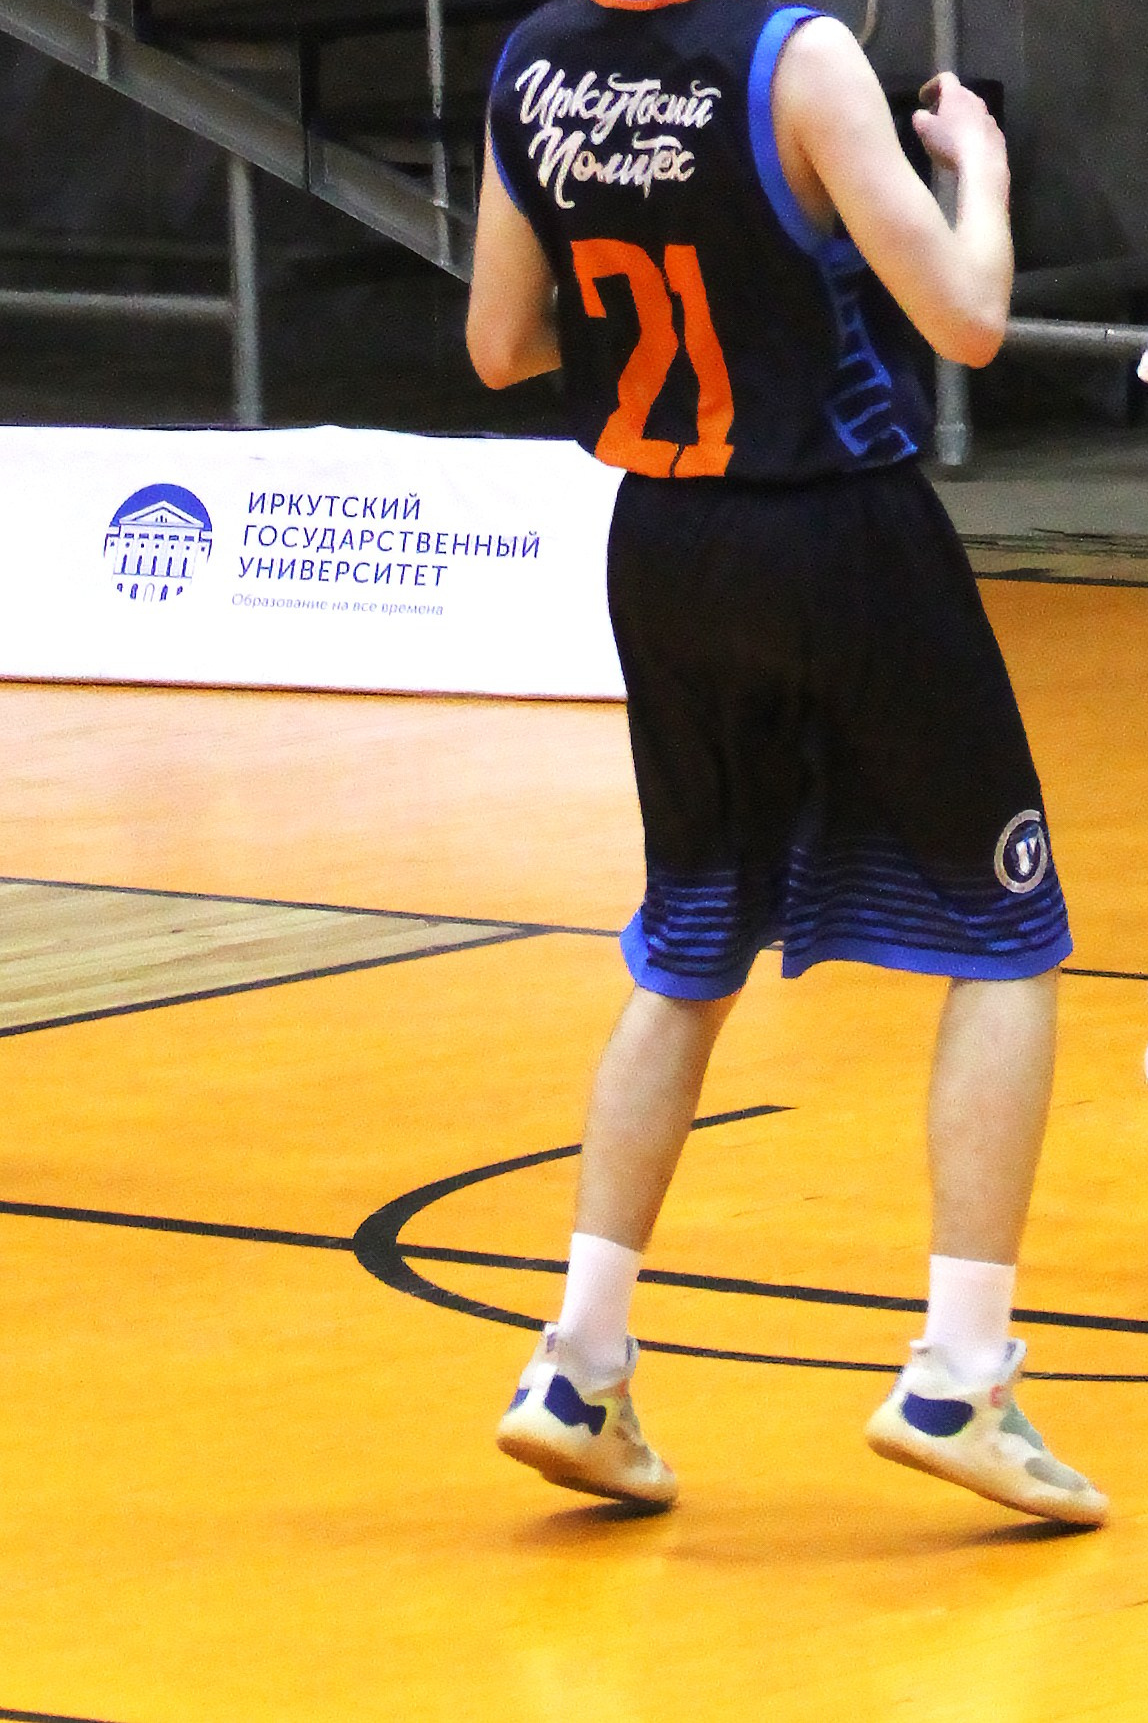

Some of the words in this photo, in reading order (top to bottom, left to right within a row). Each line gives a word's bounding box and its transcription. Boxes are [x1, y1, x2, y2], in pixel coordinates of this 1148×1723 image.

[570, 238, 735, 477] 21
[248, 491, 421, 520] ИРКУТСКИЙ
[243, 524, 540, 559] ГОСУДАРСТВЕННЫЙ
[238, 556, 448, 587] УНИВЕРСИТЕТ
[231, 593, 328, 610] Образование
[332, 600, 349, 612] на
[353, 601, 377, 613] все
[381, 602, 444, 616] времена
